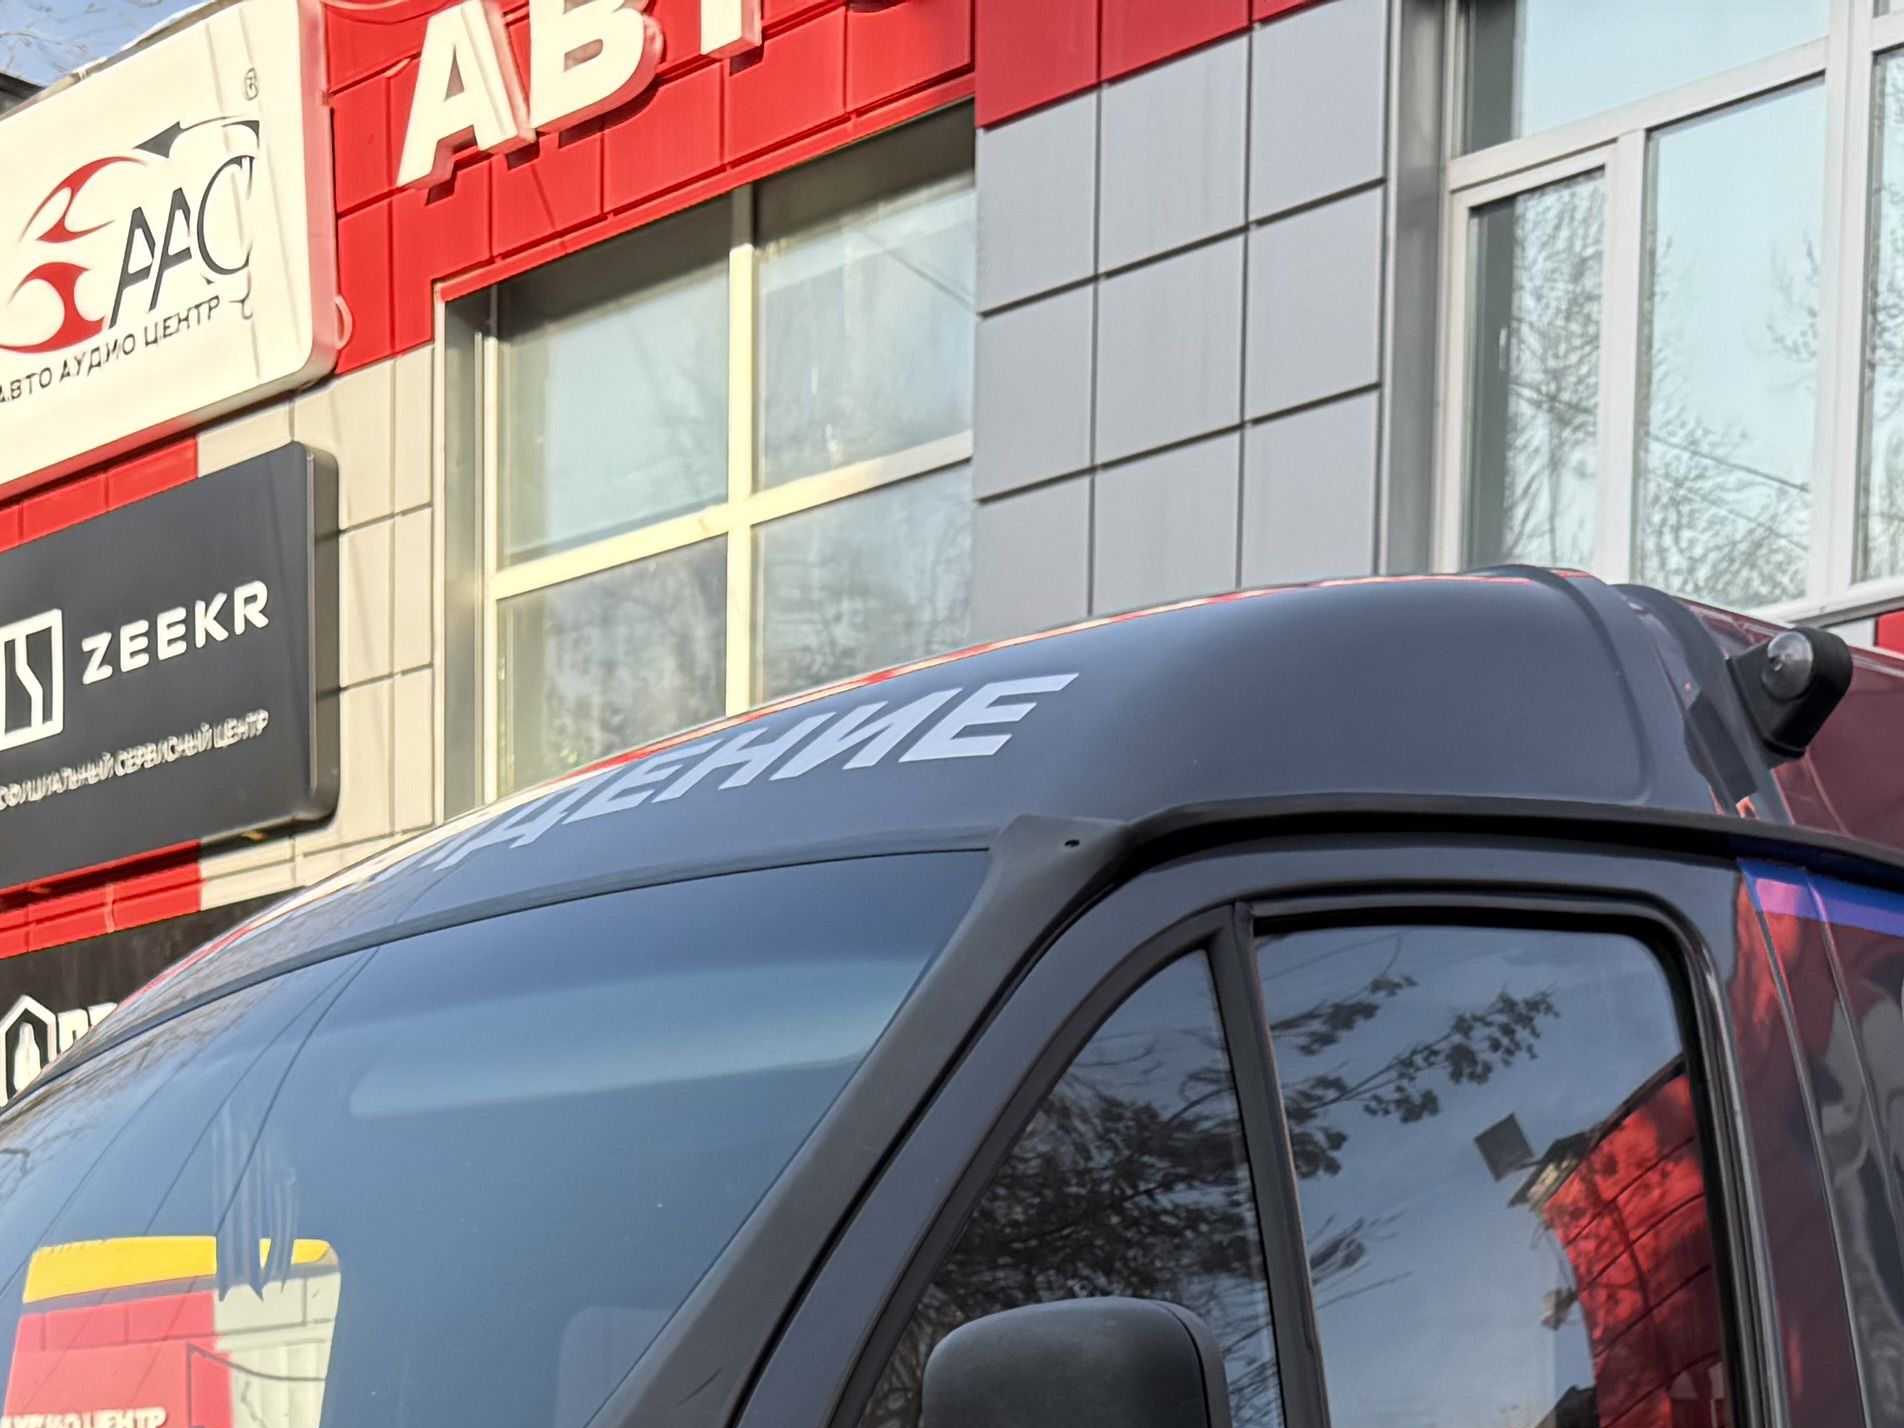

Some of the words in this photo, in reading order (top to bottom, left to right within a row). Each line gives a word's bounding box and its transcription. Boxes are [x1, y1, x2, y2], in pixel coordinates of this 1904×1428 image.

[59, 333, 136, 383] АУДИО
[144, 295, 221, 348] ЦЕНТР
[81, 580, 269, 685] ZEEKR
